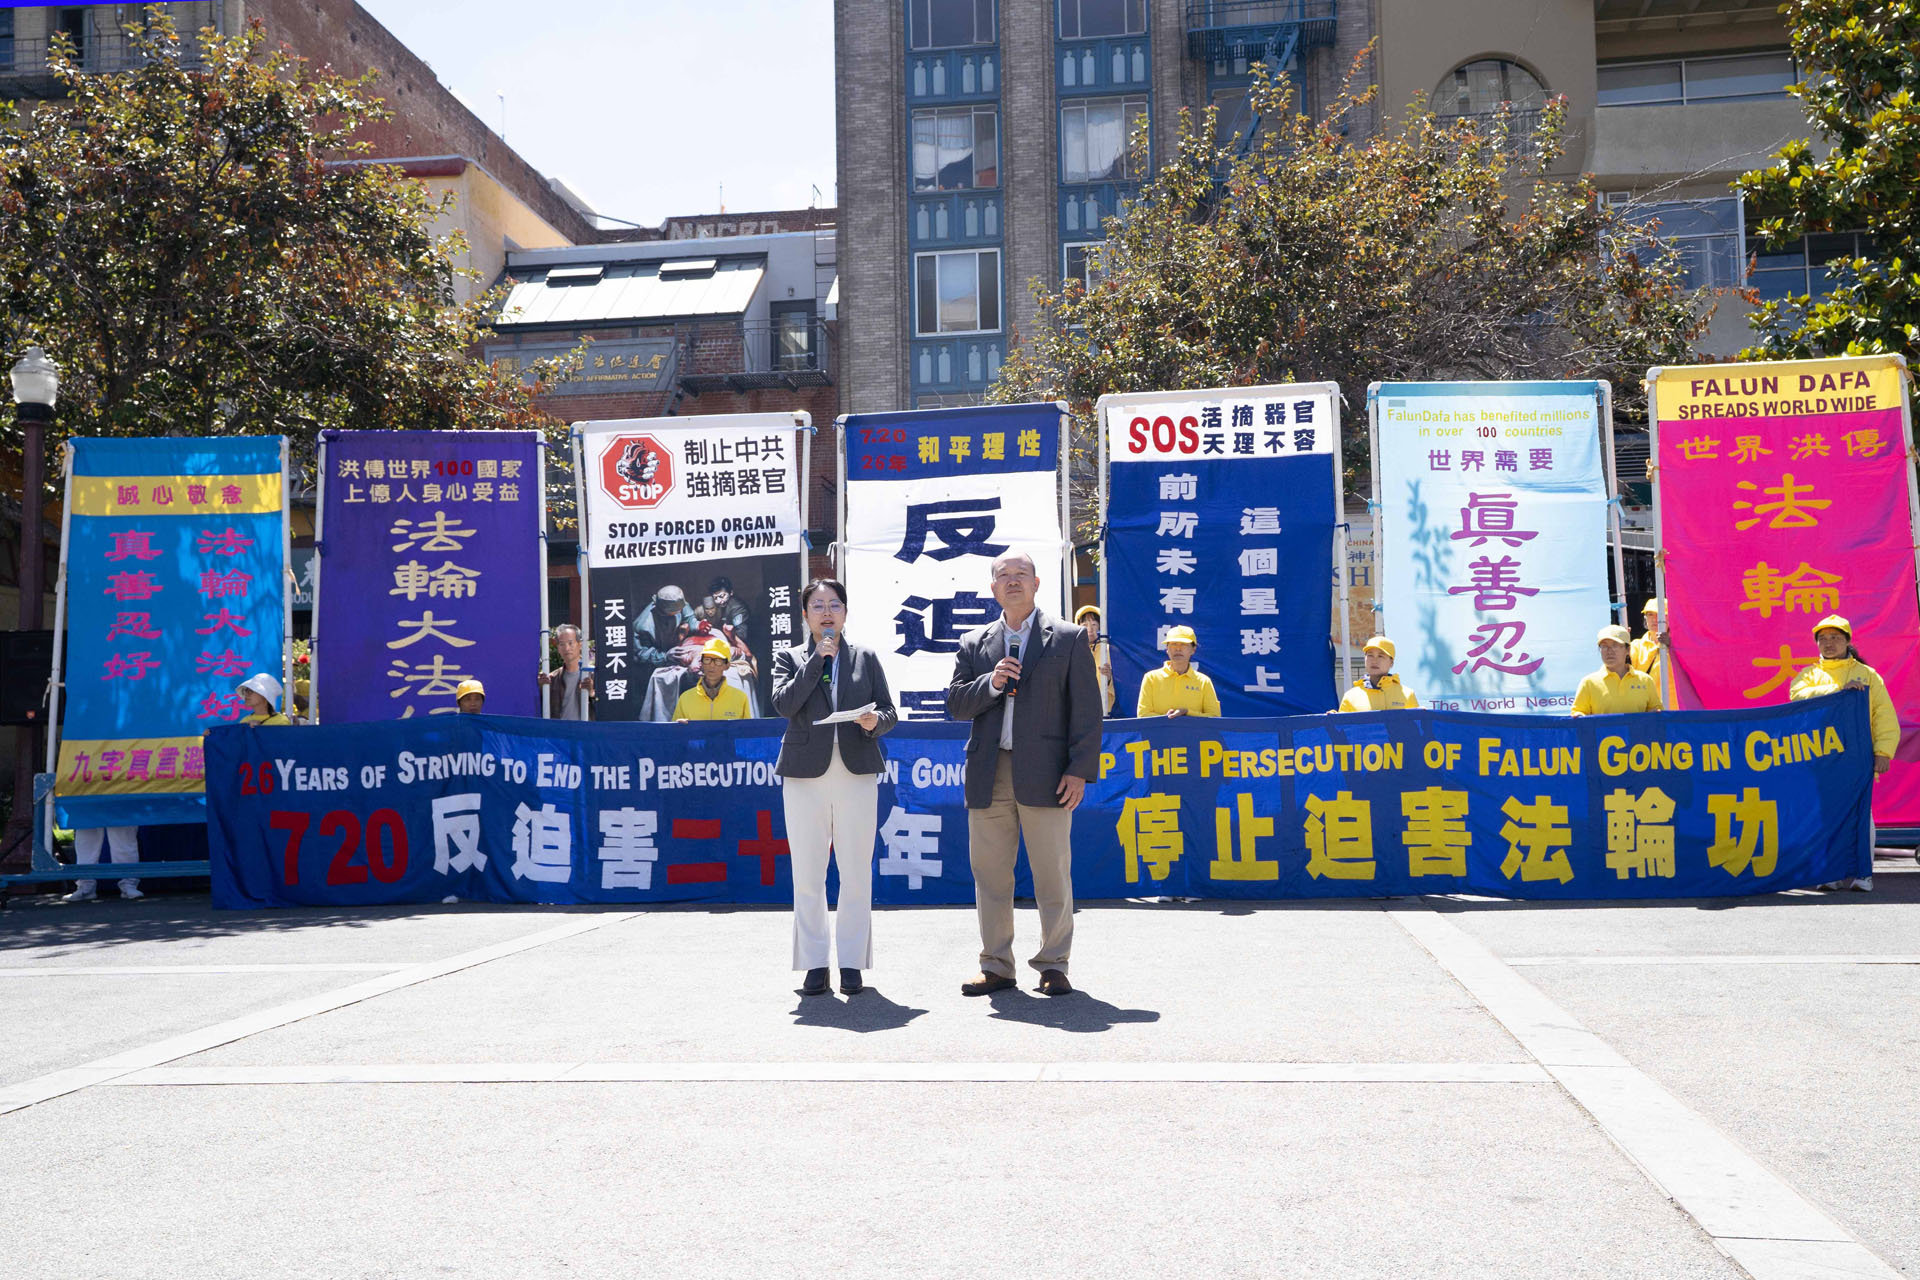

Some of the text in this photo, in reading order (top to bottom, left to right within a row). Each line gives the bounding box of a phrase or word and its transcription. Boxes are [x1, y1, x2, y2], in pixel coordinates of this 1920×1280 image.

[586, 373, 629, 382] AFFIRMATIVE
[631, 372, 657, 380] ACTION
[1691, 370, 1871, 398] FALUN DAFA
[1201, 400, 1315, 428] 活摘器官
[1454, 410, 1476, 422] has
[1480, 409, 1537, 422] benefited
[1540, 409, 1590, 422] millions
[1678, 401, 1760, 420] SPREADS
[859, 428, 907, 444] 7.20
[1128, 415, 1200, 454] SOS
[1202, 428, 1316, 455] 天理不容
[1418, 425, 1563, 438] in over 100 countries
[683, 435, 785, 466] 制止中共
[918, 428, 1041, 464] 和平理性
[1675, 429, 1888, 464] 世界洪傳
[861, 455, 908, 472] 26年
[1428, 448, 1553, 473] 世界需要
[117, 483, 243, 506] 誠心敬念
[343, 482, 520, 503] 上億人身心受益
[618, 483, 664, 501] STOP
[686, 467, 786, 498] 強摘器官
[608, 515, 776, 539] STOP FORCED ORGAN
[604, 531, 784, 560] HARVESTING IN CHINA
[1156, 472, 1199, 672] 前所未有
[101, 529, 164, 681] 真善忍好
[386, 510, 482, 719] 法輪大法
[1237, 507, 1285, 694] 這個星球上
[195, 527, 255, 721] 法輪大法好
[604, 598, 628, 701] 天理不容
[1429, 695, 1576, 711] The World Needs
[1125, 740, 1189, 779] THE
[1199, 739, 1404, 779] PERSECUTION
[1423, 742, 1462, 770] OF
[1478, 737, 1582, 776] FALUN
[1598, 735, 1694, 777] GONG
[1702, 740, 1732, 772] IN
[1744, 725, 1845, 772] CHINA
[238, 761, 275, 796] 26
[275, 758, 349, 791] YEARS
[360, 765, 386, 789] OF
[397, 750, 496, 784] STRIVING
[501, 757, 527, 784] TO
[536, 753, 582, 789] END
[591, 765, 631, 790] THE
[638, 757, 782, 791] PERSECUTION
[1116, 786, 1780, 885] 停止迫害法輪功
